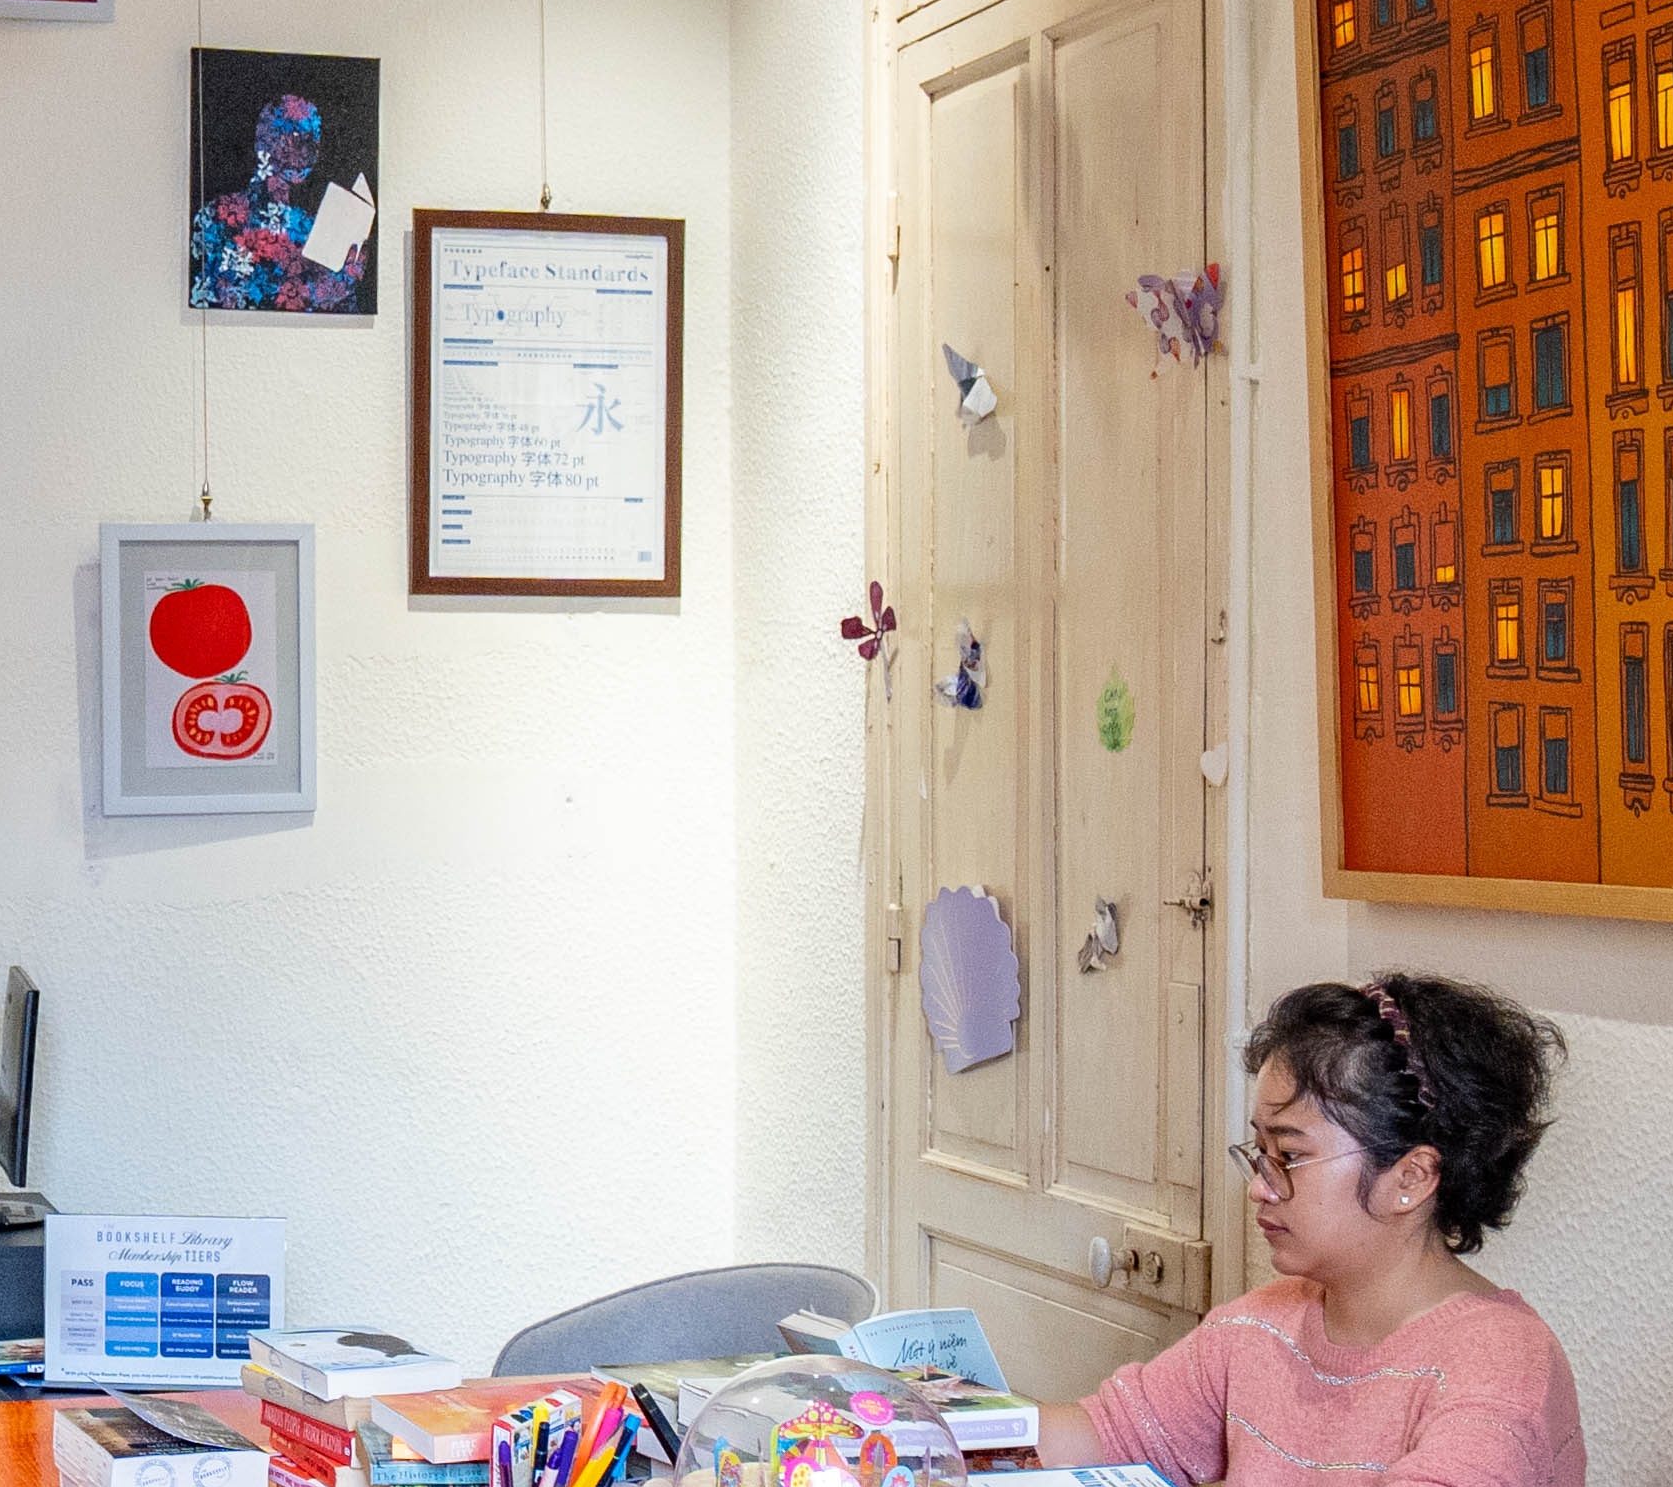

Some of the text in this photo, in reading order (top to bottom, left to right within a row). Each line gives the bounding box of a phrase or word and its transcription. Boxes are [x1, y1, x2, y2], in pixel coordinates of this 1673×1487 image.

[449, 259, 650, 283] Typeface Standards
[462, 303, 567, 329] Typography
[576, 382, 624, 436] 永
[443, 421, 493, 432] Typography
[443, 434, 506, 450] Typography
[508, 435, 533, 449] 字体
[551, 438, 562, 450] pt
[443, 449, 586, 469] Typography 字体 72 pt
[443, 468, 599, 490] Typography 字体 80 pt
[96, 1231, 233, 1250] BOOKSHELF Library
[109, 1247, 221, 1266] Membership TIERS
[71, 1278, 94, 1287] PASS
[120, 1280, 145, 1288] FOCUS
[171, 1278, 204, 1286] READING
[232, 1279, 254, 1287] FLOW
[375, 1469, 483, 1482] The History of Love
